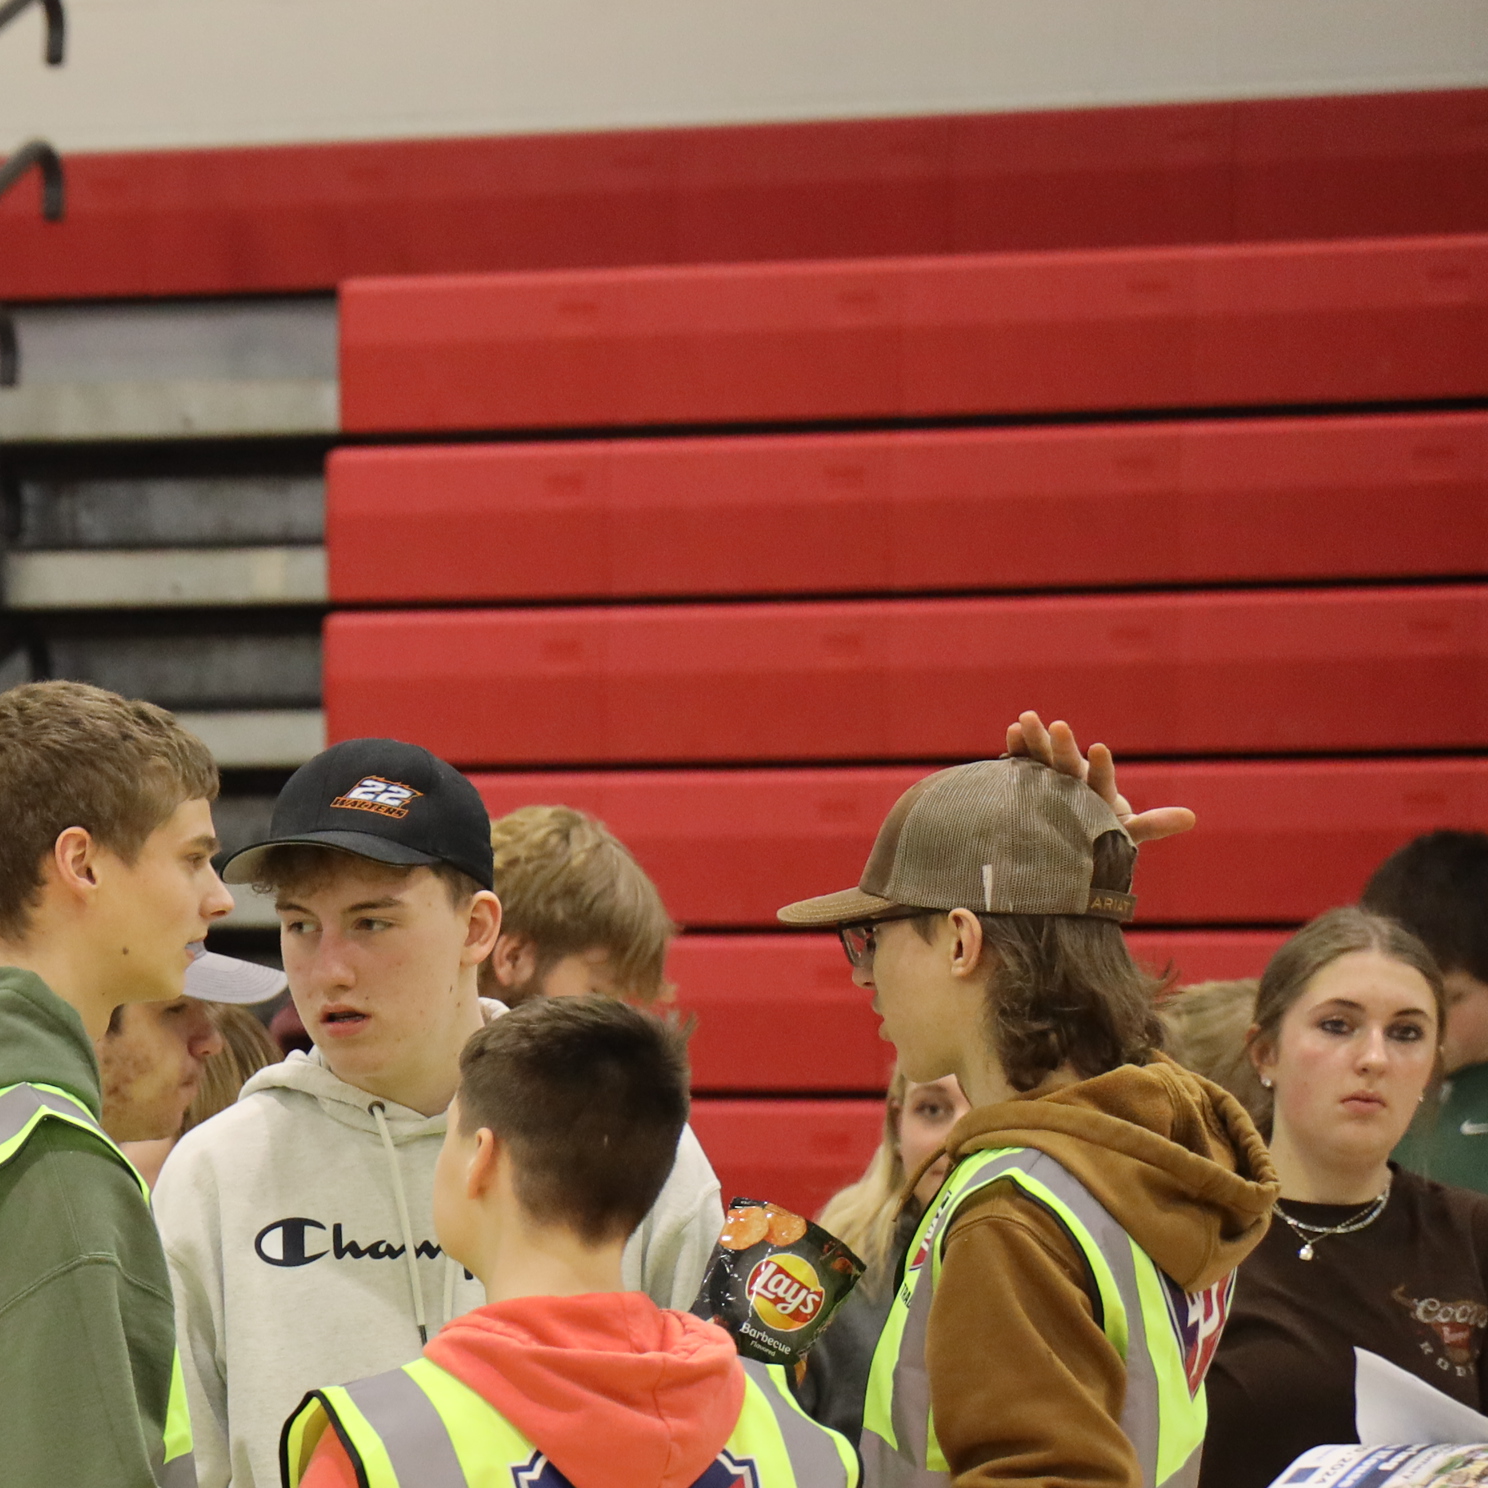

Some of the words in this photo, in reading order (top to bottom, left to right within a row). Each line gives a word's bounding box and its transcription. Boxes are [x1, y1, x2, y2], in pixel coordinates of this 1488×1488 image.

[346, 779, 415, 808] 22
[254, 1217, 473, 1280] Cham
[751, 1263, 821, 1315] Lay's
[739, 1322, 792, 1355] Barbecue
